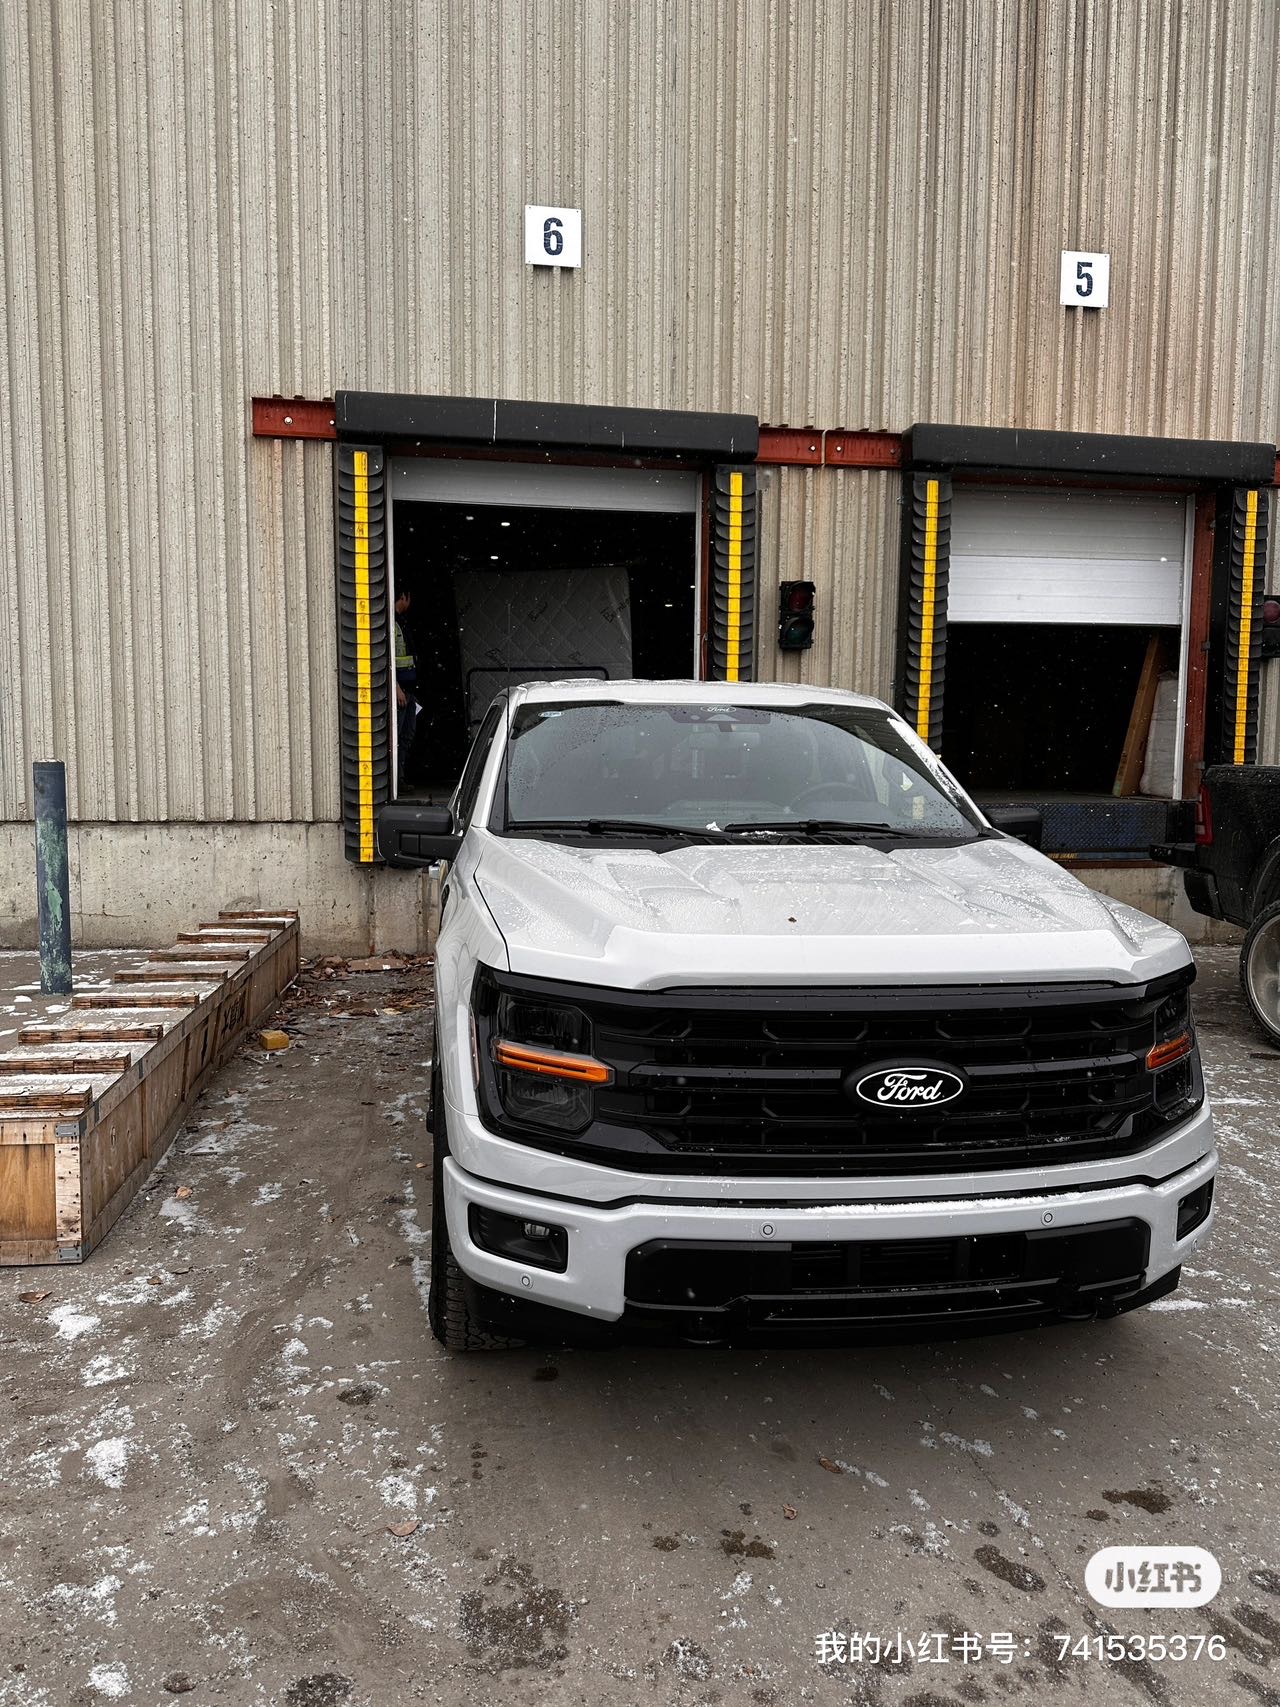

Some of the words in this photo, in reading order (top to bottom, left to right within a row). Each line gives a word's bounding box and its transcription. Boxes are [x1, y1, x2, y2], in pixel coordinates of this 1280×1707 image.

[543, 217, 563, 256] 6
[1076, 261, 1093, 297] 5
[877, 1073, 943, 1101] Ford
